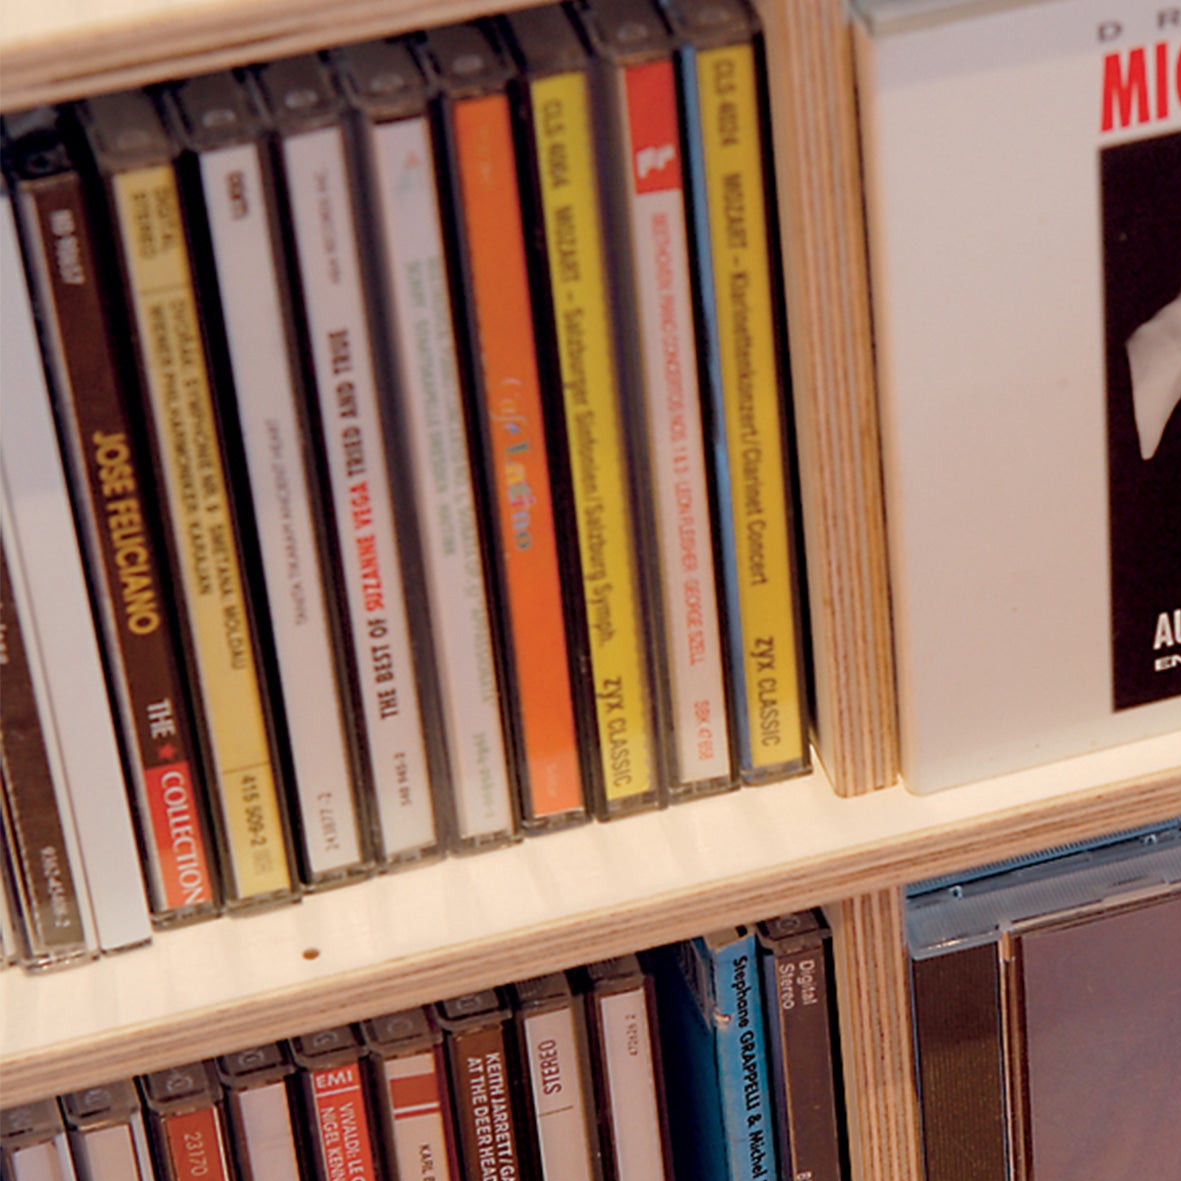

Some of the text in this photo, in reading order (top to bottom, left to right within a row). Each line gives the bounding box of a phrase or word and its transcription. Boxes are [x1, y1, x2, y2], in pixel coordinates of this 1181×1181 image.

[554, 205, 579, 280] MOZART
[722, 172, 747, 248] MOZART
[746, 519, 768, 585] Concert
[93, 431, 158, 633] JOSE FELICIANO
[328, 329, 398, 719] THE BEST OF SUZANNE VEGA TRIED AND TRUE
[757, 677, 780, 746] CLASSIC
[606, 717, 632, 786] CLASSIC
[147, 698, 203, 904] THE COLLECTION
[241, 775, 259, 802] 415
[244, 805, 266, 846] 509-2
[731, 955, 751, 1027] Stephane
[778, 963, 798, 1009] Stereo
[793, 959, 817, 1005] Digital
[314, 1069, 352, 1088] EMI
[467, 1057, 483, 1072] AT
[485, 1052, 504, 1095] KEITH
[537, 1039, 561, 1095] STEREO
[739, 1030, 760, 1110] GRAPPELLI
[470, 1075, 487, 1104] THE
[321, 1106, 339, 1145] NIGEL
[339, 1101, 359, 1158] VIVALDI:
[473, 1105, 492, 1145] DEER
[491, 1097, 512, 1156] JARRETT
[746, 1113, 762, 1128] &
[183, 1131, 208, 1176] 23170
[347, 1159, 364, 1174] LE
[419, 1143, 433, 1174] KARL
[749, 1130, 767, 1178] Michel
